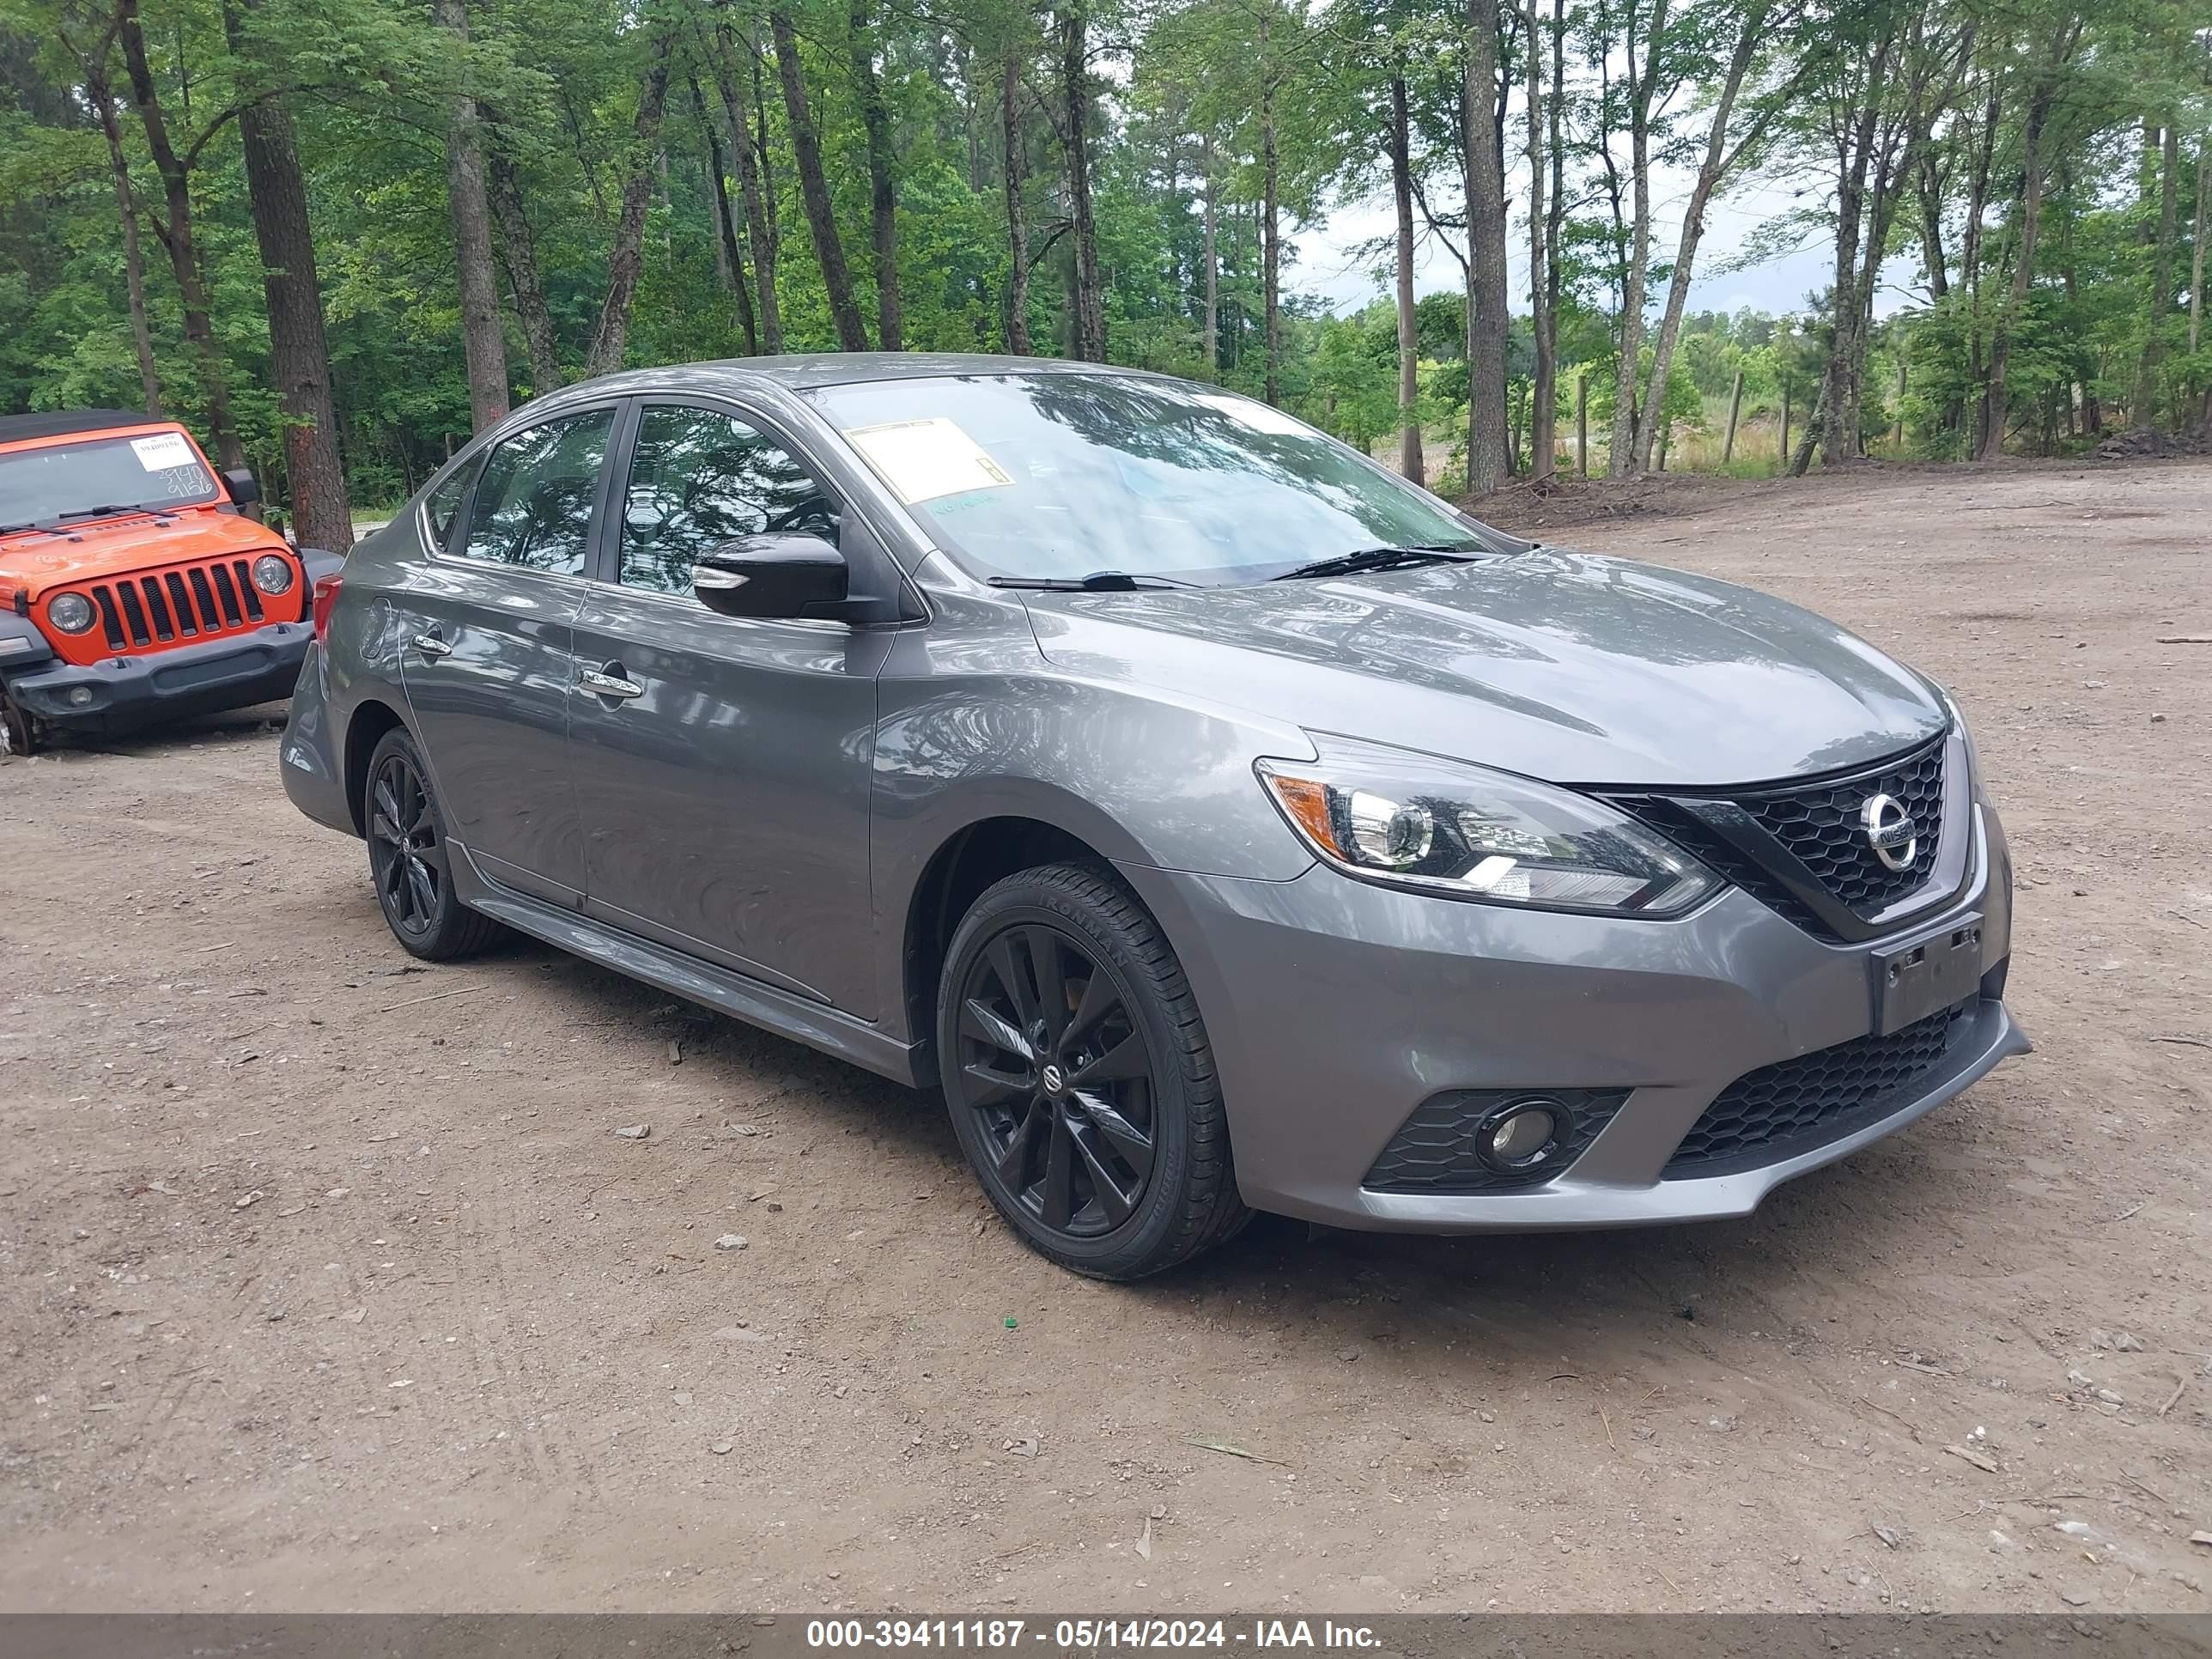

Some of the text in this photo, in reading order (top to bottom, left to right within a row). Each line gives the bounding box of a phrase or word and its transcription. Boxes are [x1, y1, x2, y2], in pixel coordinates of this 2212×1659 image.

[155, 465, 204, 486] 3940
[167, 479, 213, 498] 9156
[1037, 892, 1127, 968] IRONMAN
